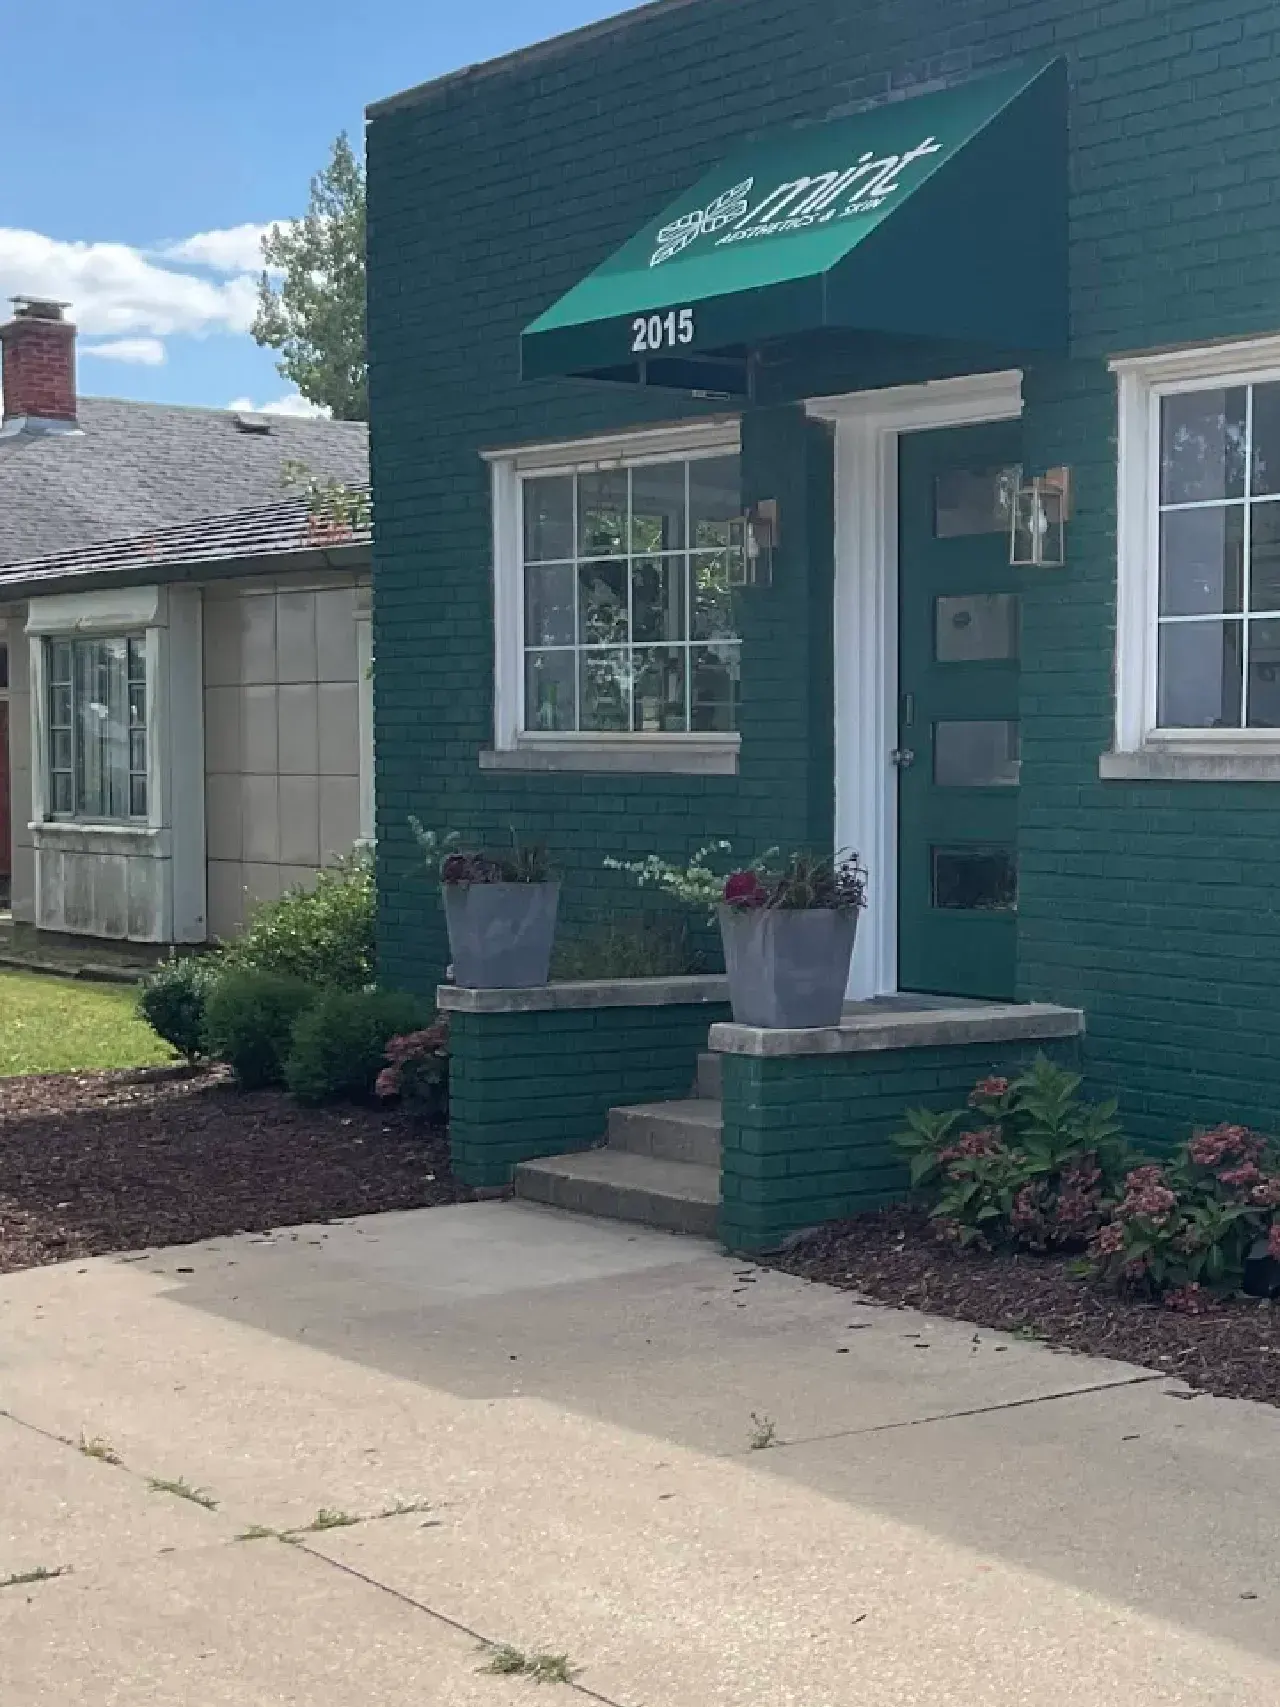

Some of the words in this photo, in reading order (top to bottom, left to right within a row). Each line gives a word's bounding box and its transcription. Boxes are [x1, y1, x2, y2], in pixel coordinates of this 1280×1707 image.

[733, 136, 943, 230] mint
[714, 212, 821, 246] AESTHETICS
[632, 308, 694, 352] 2015
